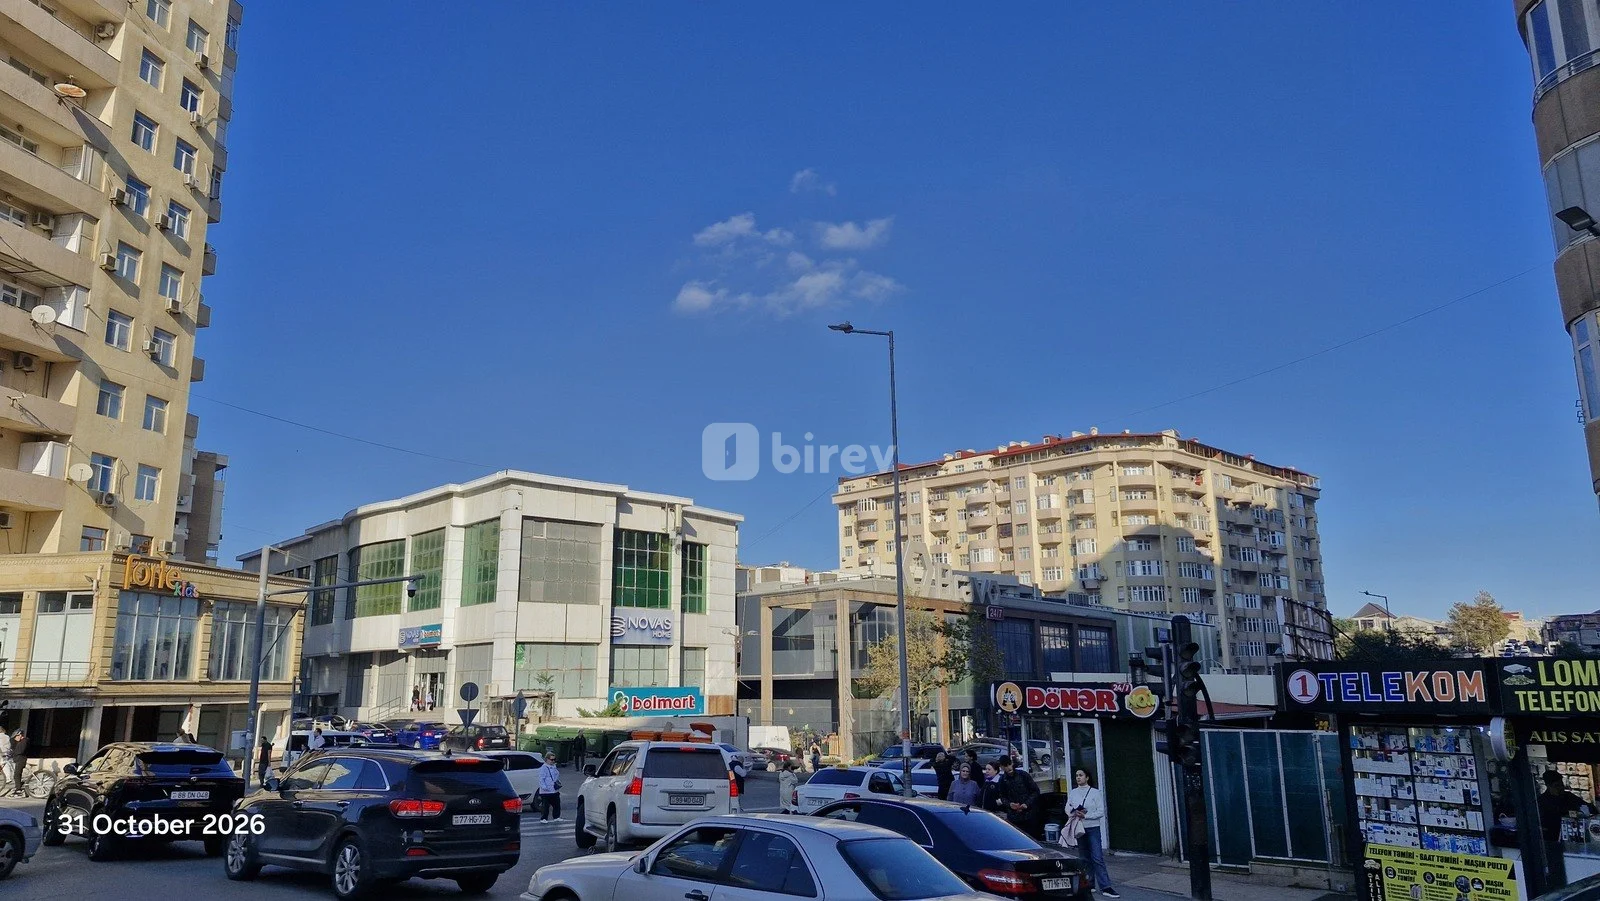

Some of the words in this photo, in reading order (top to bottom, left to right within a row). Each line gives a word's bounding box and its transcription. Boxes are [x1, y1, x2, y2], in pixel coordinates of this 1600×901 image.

[628, 616, 671, 630] NOVAS
[652, 630, 671, 639] HOME
[1538, 660, 1600, 686] LOM
[1112, 683, 1130, 693] 24/7
[1317, 670, 1486, 703] TELEKOM
[631, 694, 695, 710] bolmart
[1529, 730, 1568, 744] ALIŞ
[1369, 847, 1392, 857] TELEFON
[1393, 850, 1415, 860] TƏMİRİ
[1419, 853, 1435, 862] SAAT
[1436, 855, 1459, 865] TƏMİRİ
[1464, 859, 1486, 869] MAŞIN
[1487, 861, 1508, 871] PULTU
[1397, 867, 1418, 876] TELEFON
[1435, 872, 1449, 880] SAAT
